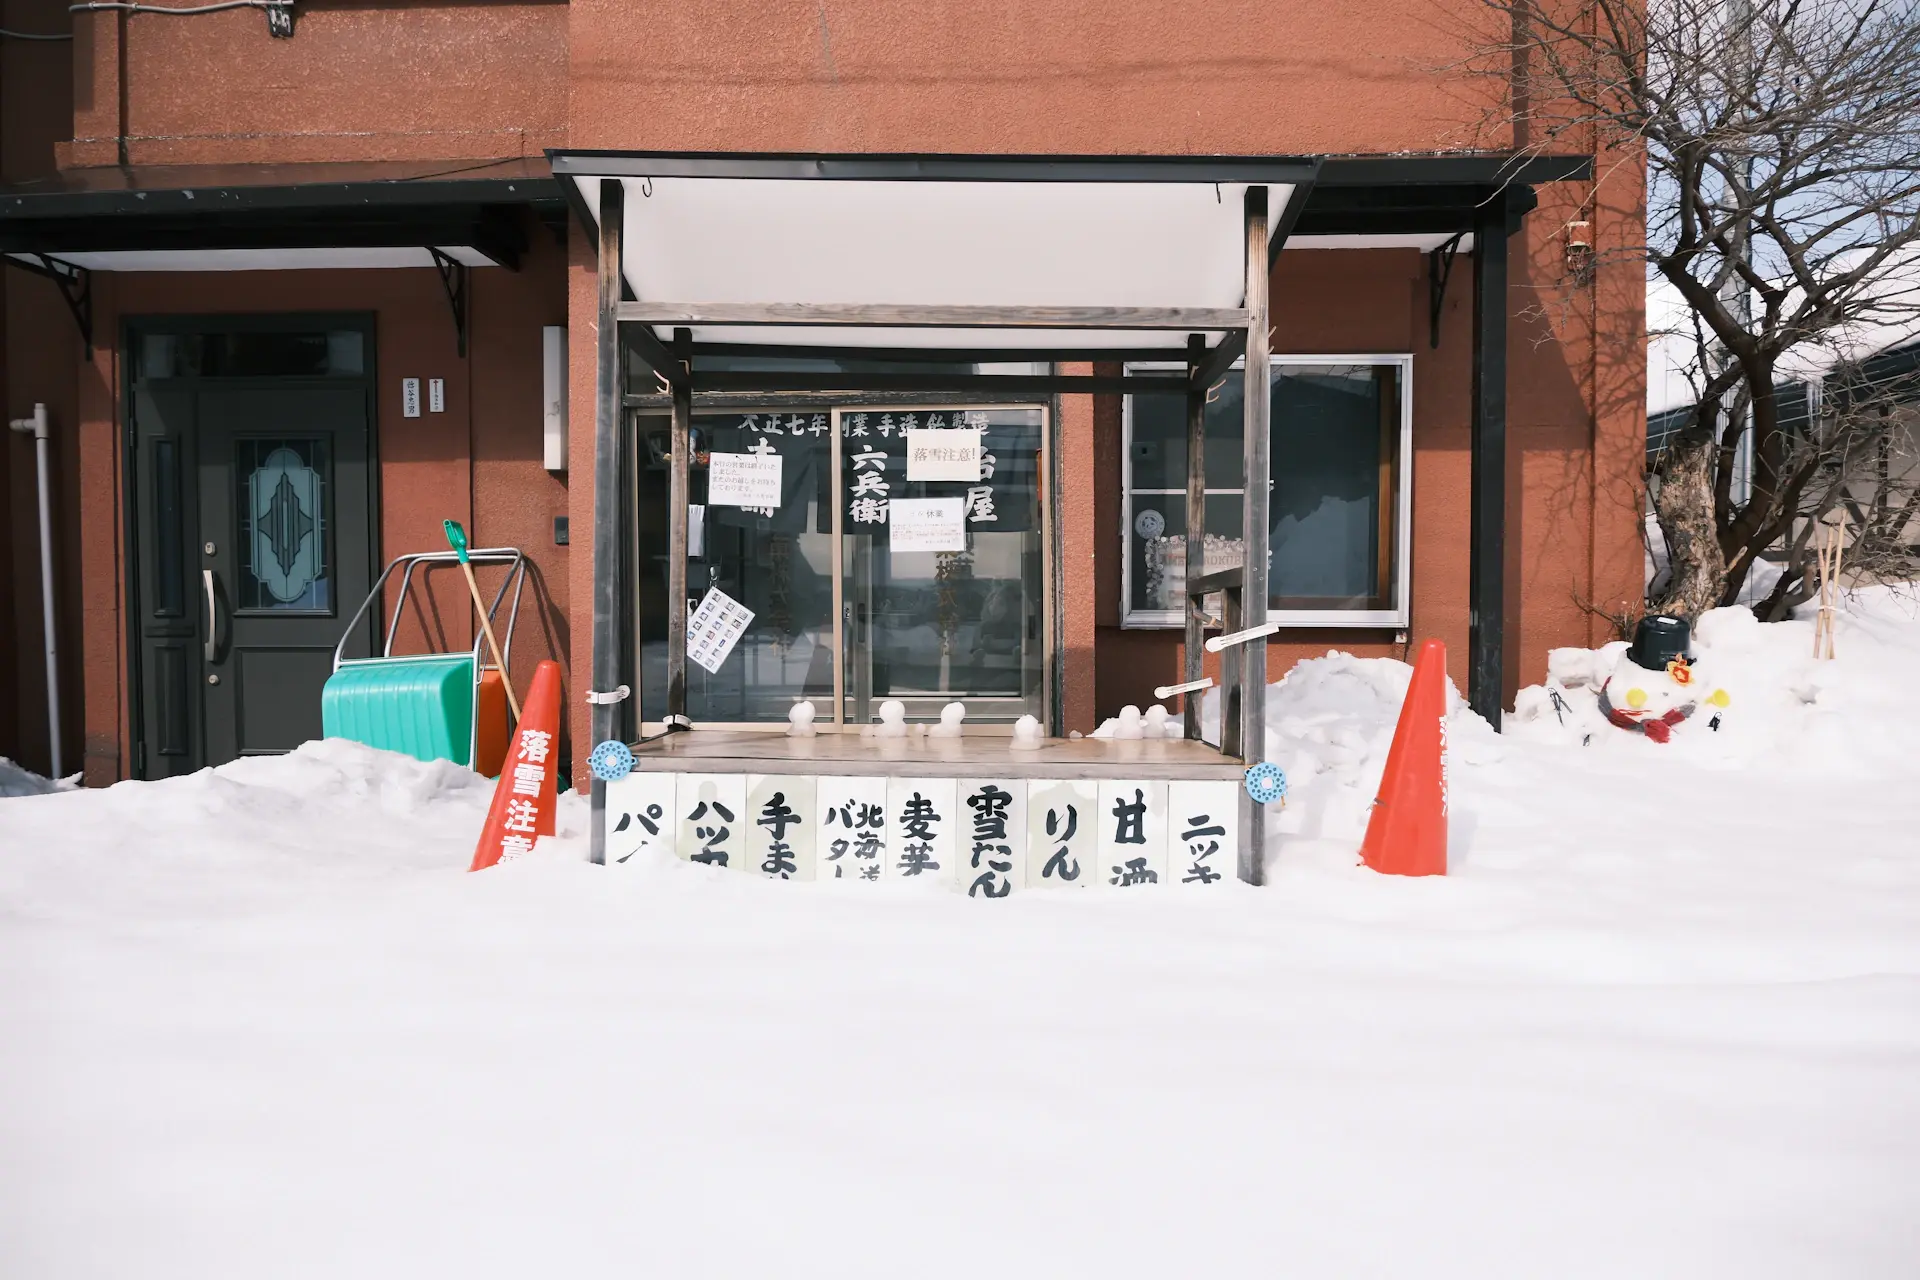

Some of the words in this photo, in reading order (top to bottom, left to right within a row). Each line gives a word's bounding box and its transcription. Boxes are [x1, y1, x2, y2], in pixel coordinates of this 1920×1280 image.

[849, 444, 890, 524] 六兵衛
[757, 791, 802, 880] 手ま
